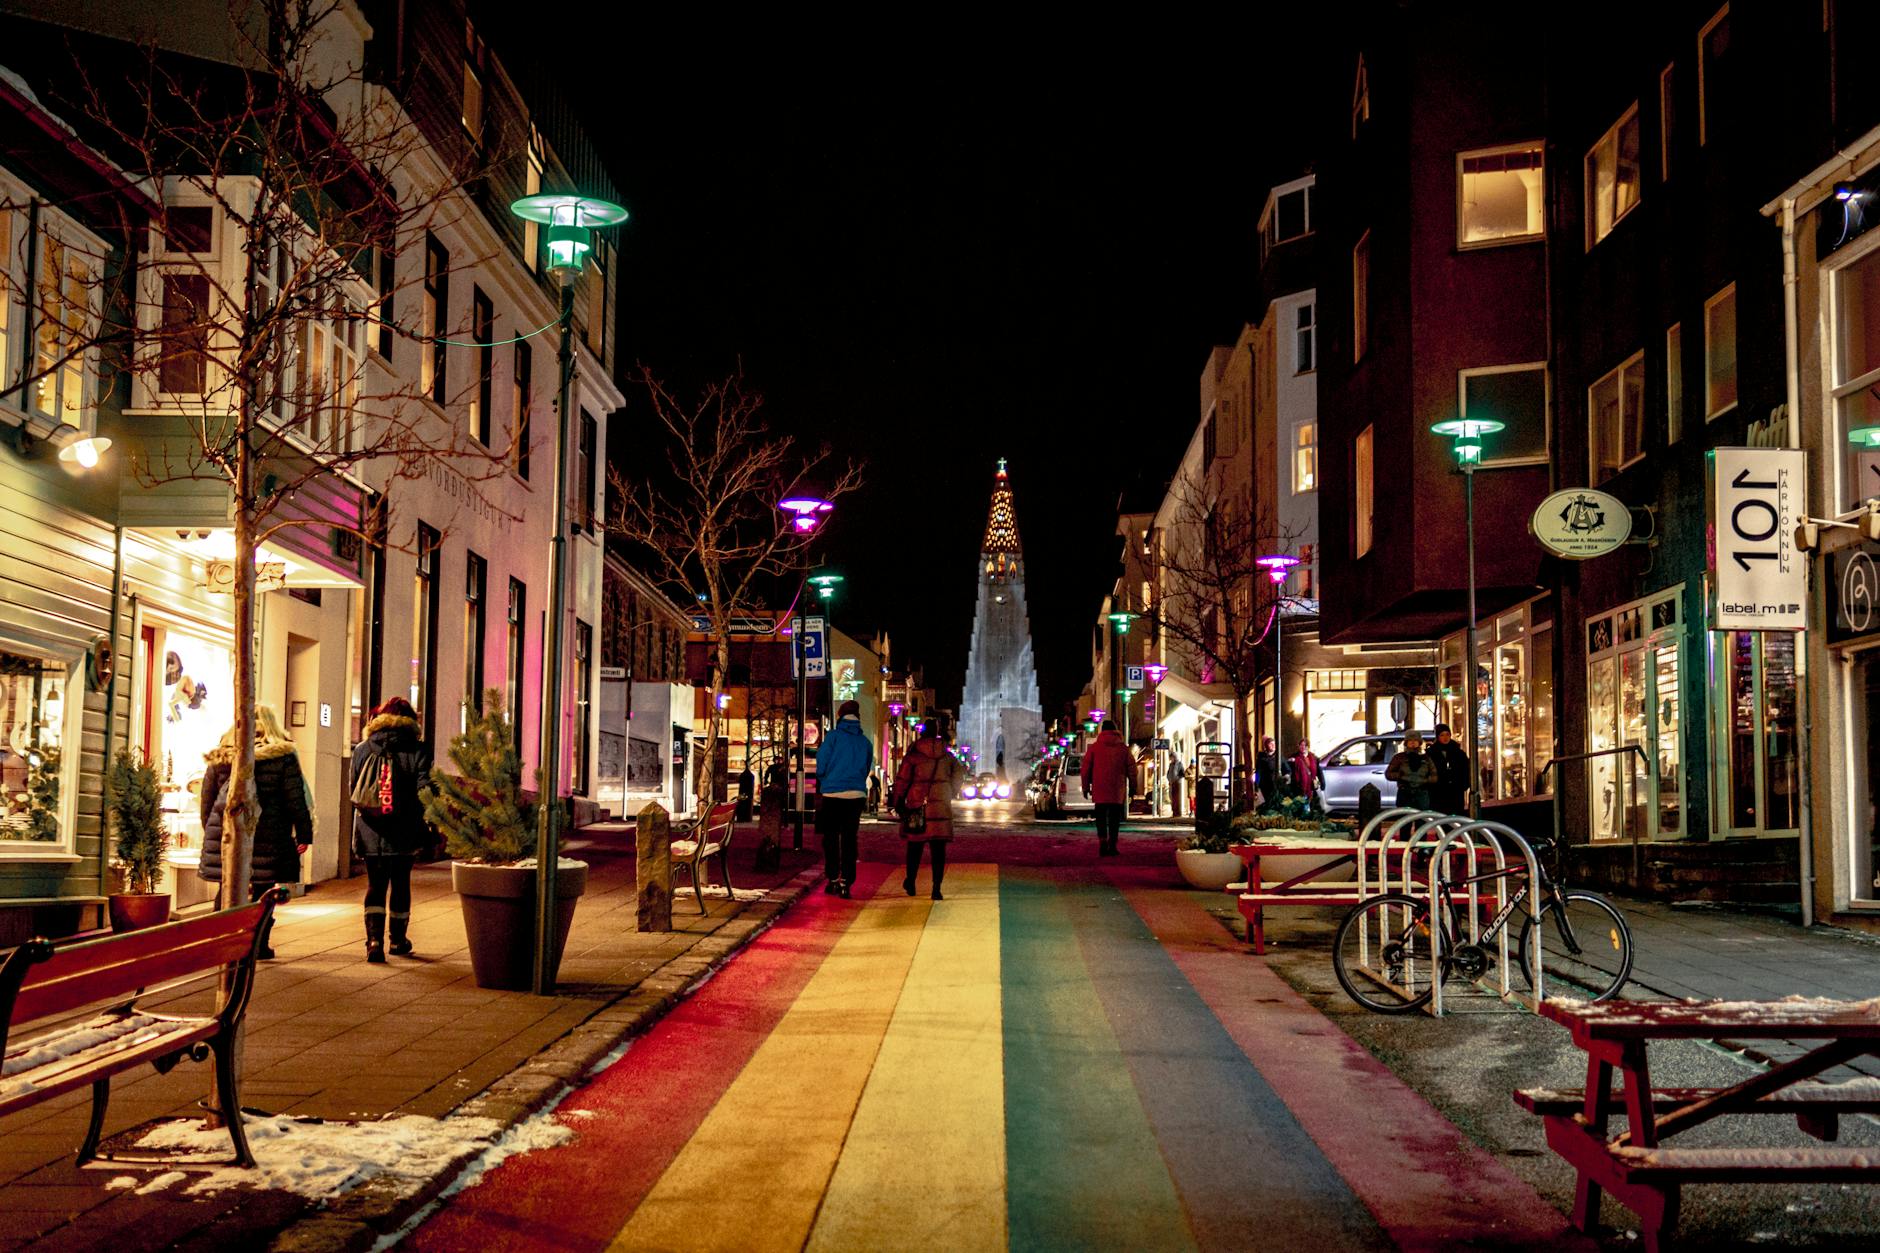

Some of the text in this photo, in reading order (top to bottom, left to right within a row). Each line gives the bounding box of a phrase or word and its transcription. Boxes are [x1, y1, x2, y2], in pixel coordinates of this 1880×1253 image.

[1731, 468, 1778, 572] 101
[1722, 603, 1777, 614] label.m
[1131, 669, 1140, 679] P
